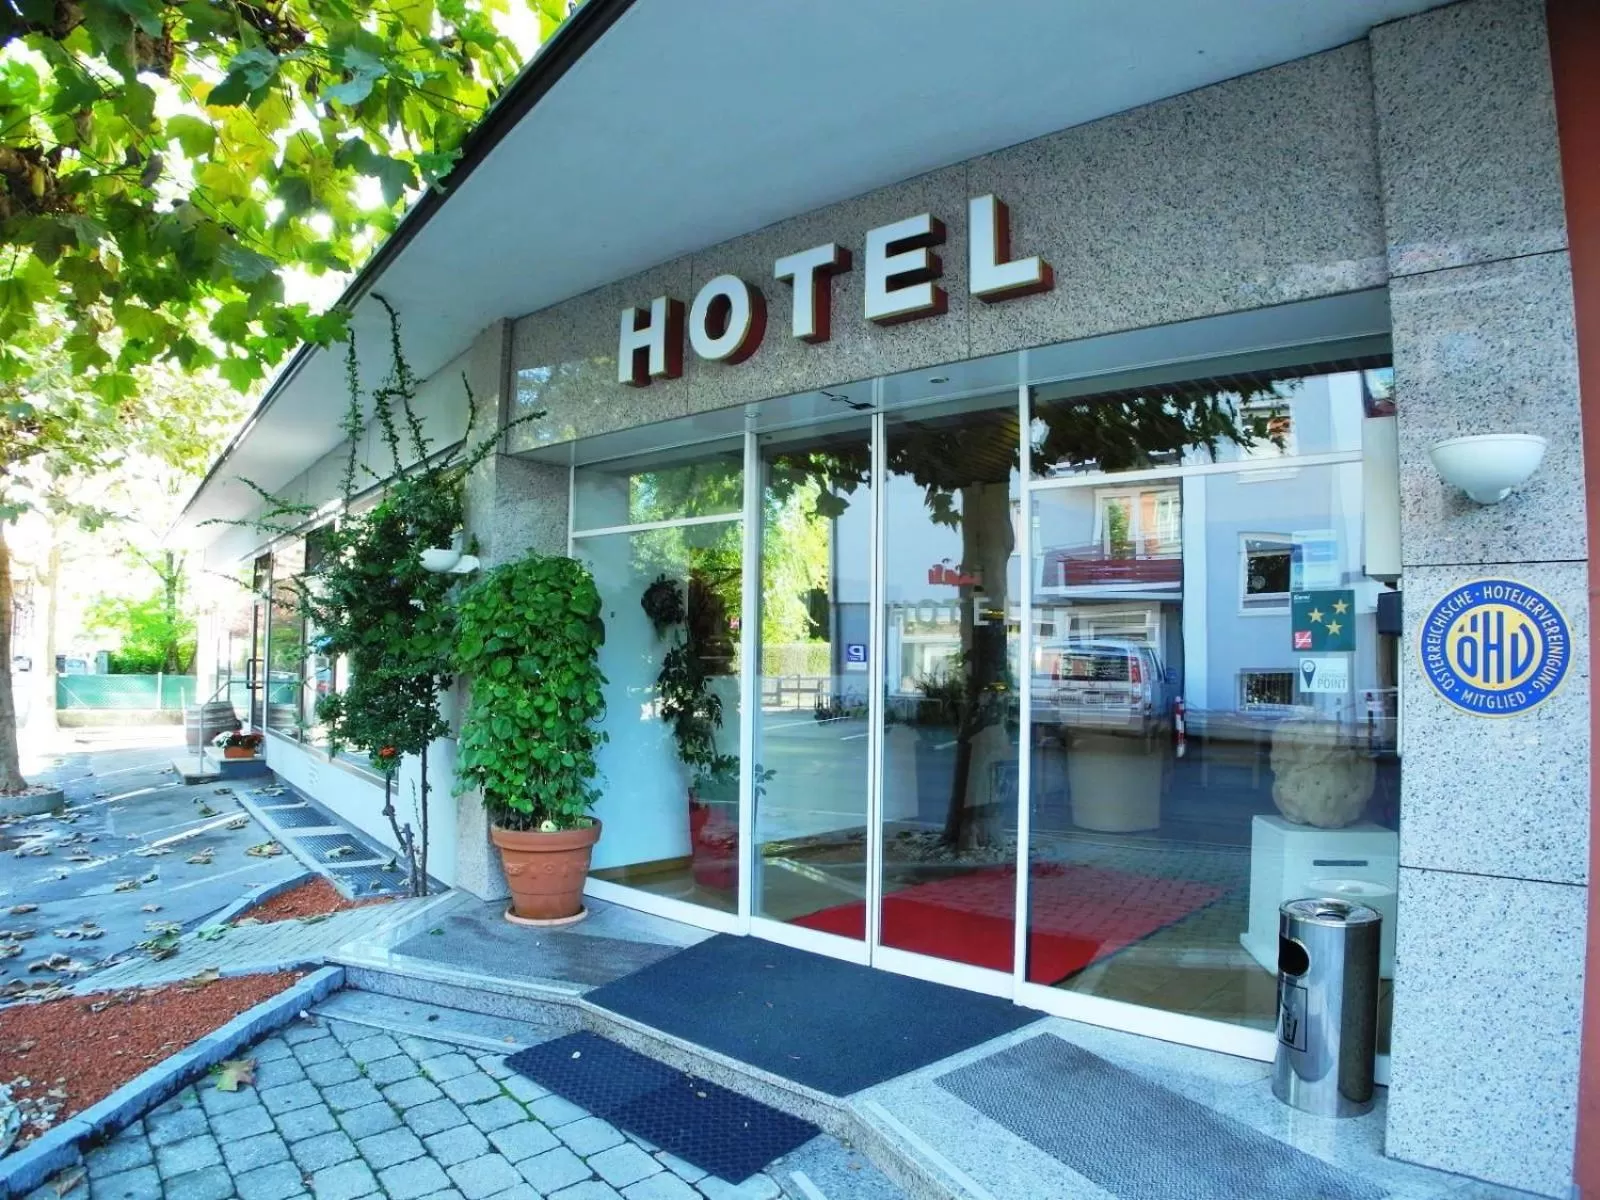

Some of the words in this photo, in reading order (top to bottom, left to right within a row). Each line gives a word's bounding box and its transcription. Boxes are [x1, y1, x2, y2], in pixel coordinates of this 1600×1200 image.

[618, 194, 1051, 386] HOTEL
[1483, 585, 1565, 693] HOTELIERVEREINIGUNG
[1317, 678, 1347, 689] POINT
[1460, 689, 1527, 709] MITGLIED
